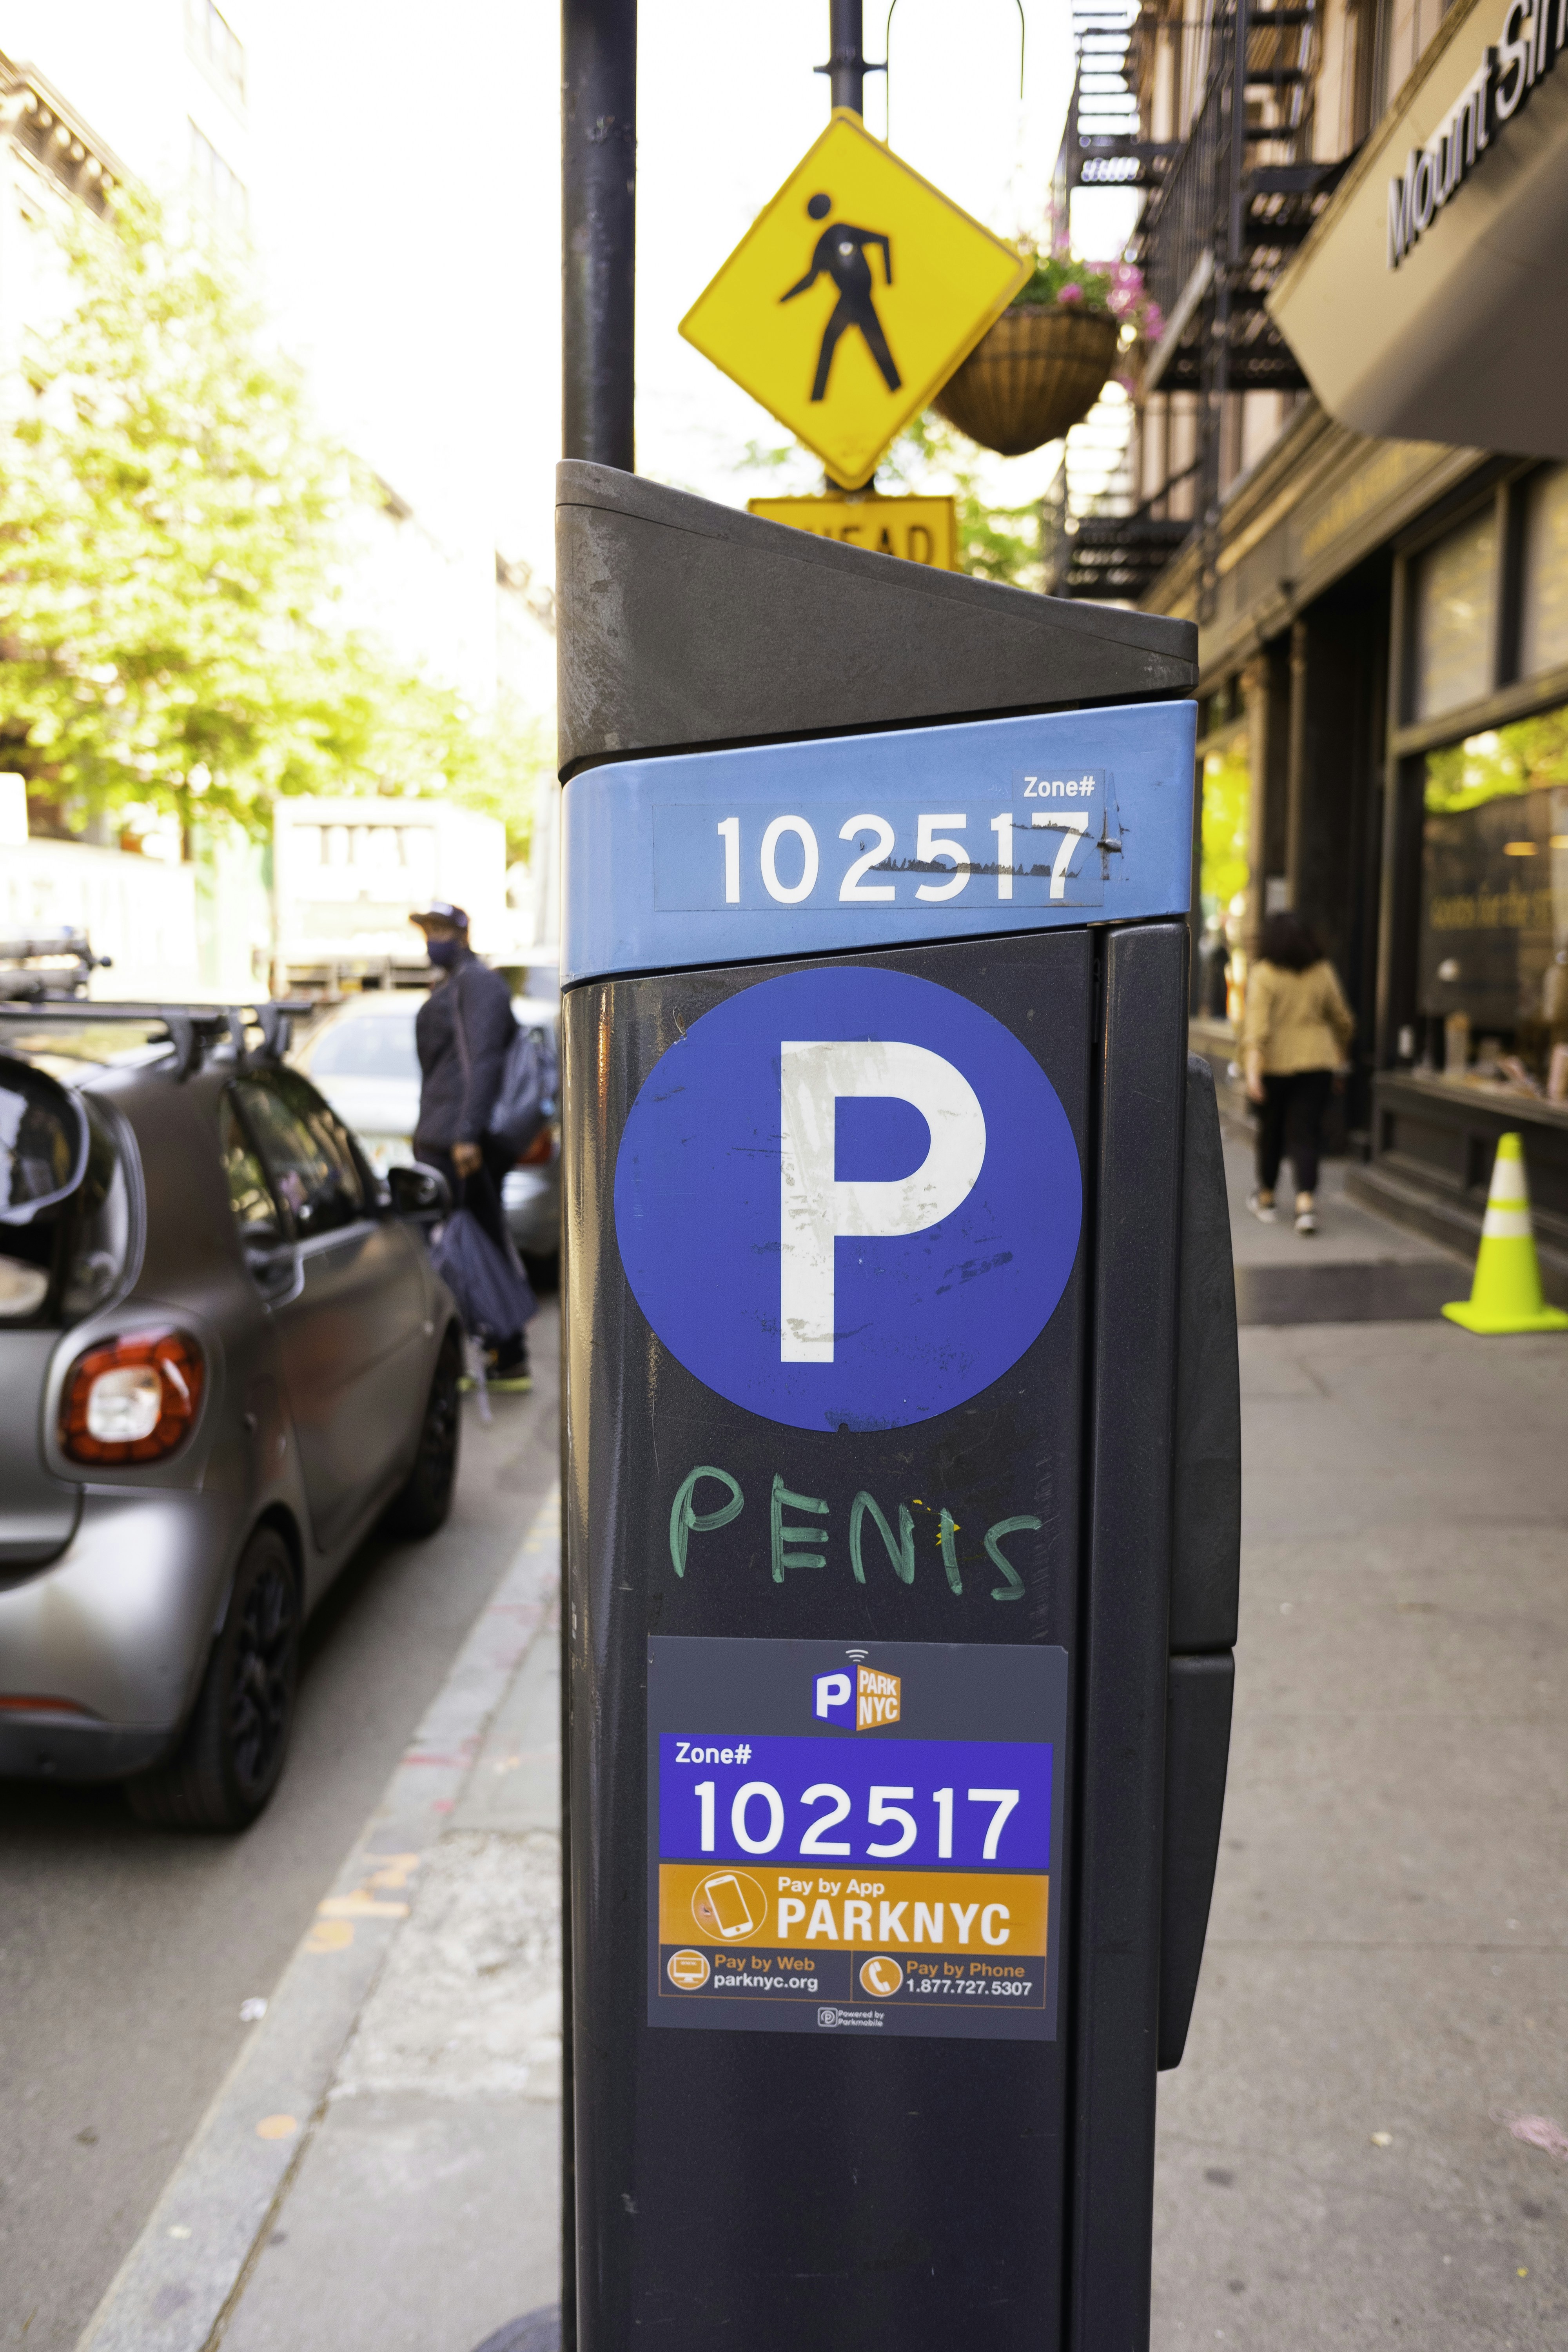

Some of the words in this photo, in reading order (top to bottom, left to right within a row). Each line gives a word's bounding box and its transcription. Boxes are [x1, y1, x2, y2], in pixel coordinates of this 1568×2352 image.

[1388, 45, 1497, 270] Mount
[1495, 0, 1568, 120] Sin
[1024, 776, 1096, 797] Zone#
[717, 811, 1089, 904] 102517
[781, 1041, 986, 1363] P
[670, 1466, 1042, 1601] PENIS
[860, 1670, 897, 1696] PARK
[817, 1673, 851, 1718] P
[859, 1696, 898, 1726] NYC
[675, 1742, 752, 1764] Zone#
[695, 1781, 1019, 1859] 102517
[778, 1877, 813, 1896] Pay
[818, 1878, 841, 1896] by
[846, 1879, 885, 1897] App
[778, 1897, 1010, 1945] PARKNYC
[715, 1954, 746, 1972] Pay
[751, 1955, 772, 1973] by
[777, 1956, 815, 1971] Web
[907, 1960, 939, 1978] Pay
[944, 1962, 965, 1979] by
[970, 1962, 1025, 1978] Phone
[714, 1973, 818, 1993] parknyc.org
[906, 1978, 1033, 1996] 1.877.727.5307
[838, 2010, 873, 2019] Powered
[875, 2011, 885, 2020] by
[838, 2018, 884, 2027] Parkmobile
